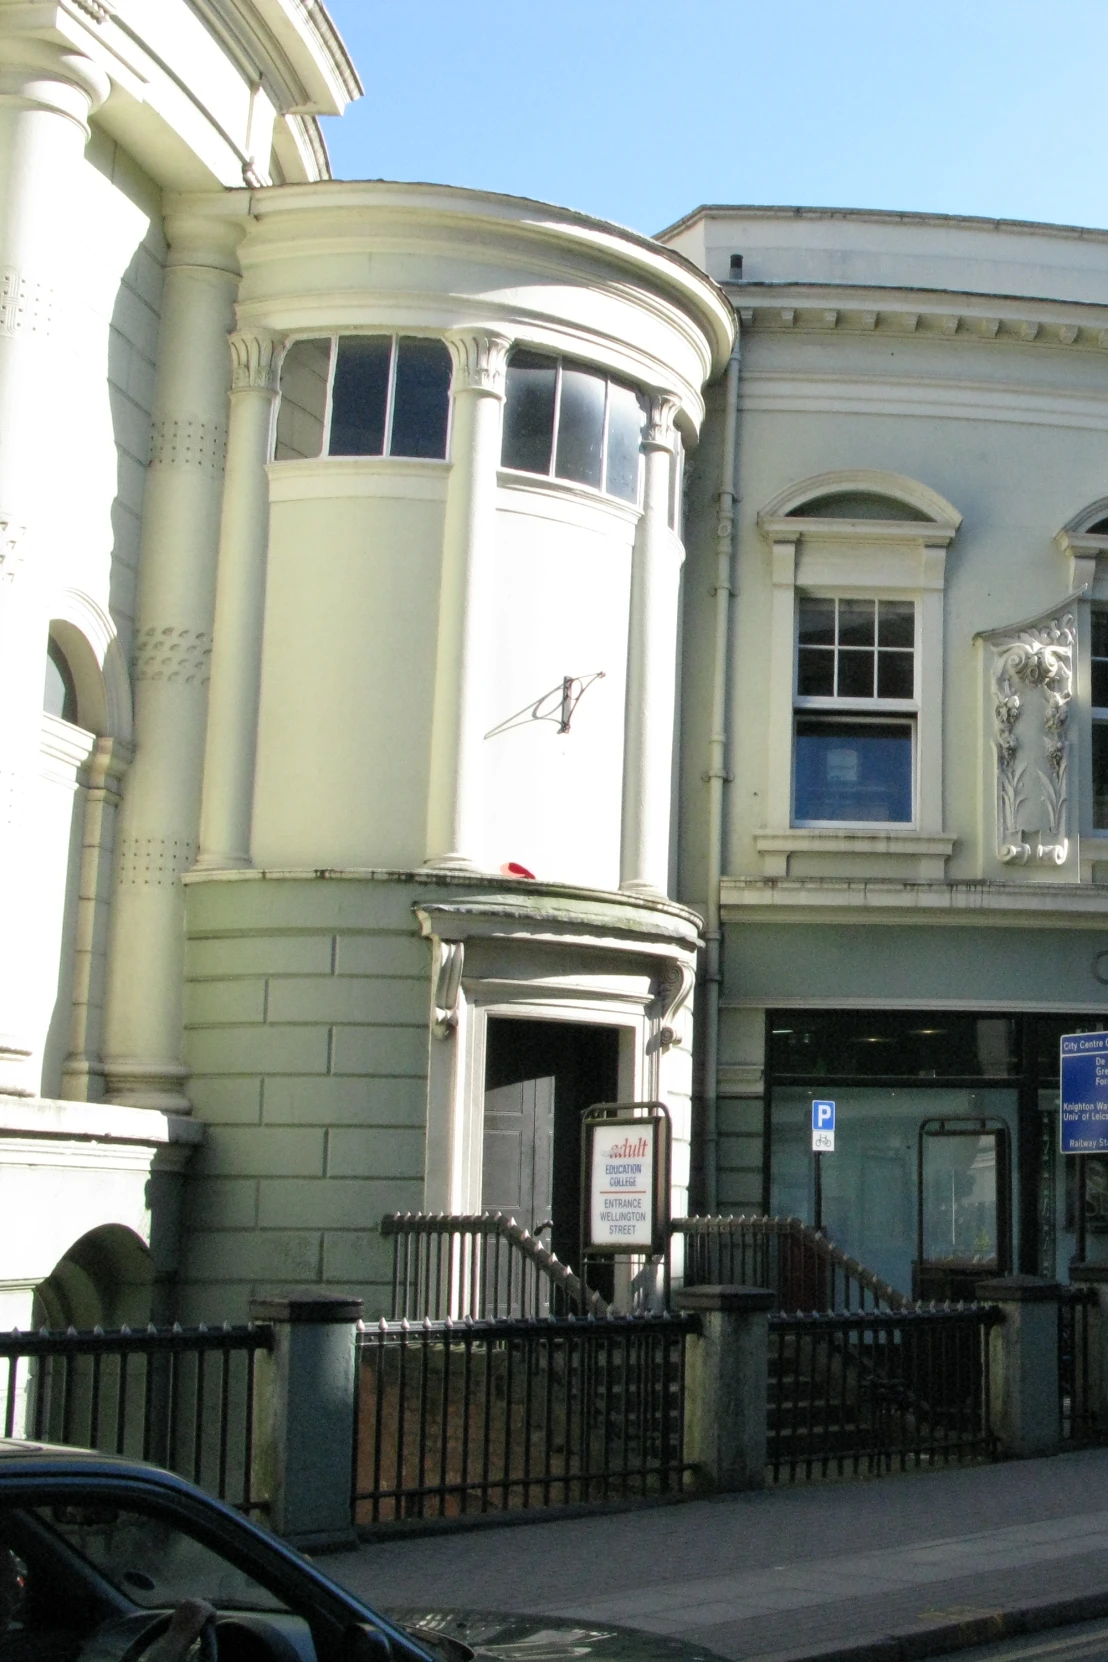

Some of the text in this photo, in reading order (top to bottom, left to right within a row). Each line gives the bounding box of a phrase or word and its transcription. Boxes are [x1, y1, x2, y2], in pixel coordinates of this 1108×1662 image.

[1063, 1041, 1078, 1051] City
[1080, 1039, 1104, 1049] Centre
[1095, 1057, 1106, 1066] De
[1063, 1102, 1095, 1113] Knighton
[818, 1104, 832, 1128] P
[1081, 1112, 1089, 1120] of
[609, 1137, 649, 1158] adult
[1069, 1139, 1097, 1149] Railway
[605, 1163, 642, 1175] EDUCATION
[609, 1176, 637, 1187] COLLEGE
[604, 1198, 642, 1209] ENTRANCE
[600, 1211, 646, 1222] WELLINGTON
[609, 1224, 637, 1235] STREET
